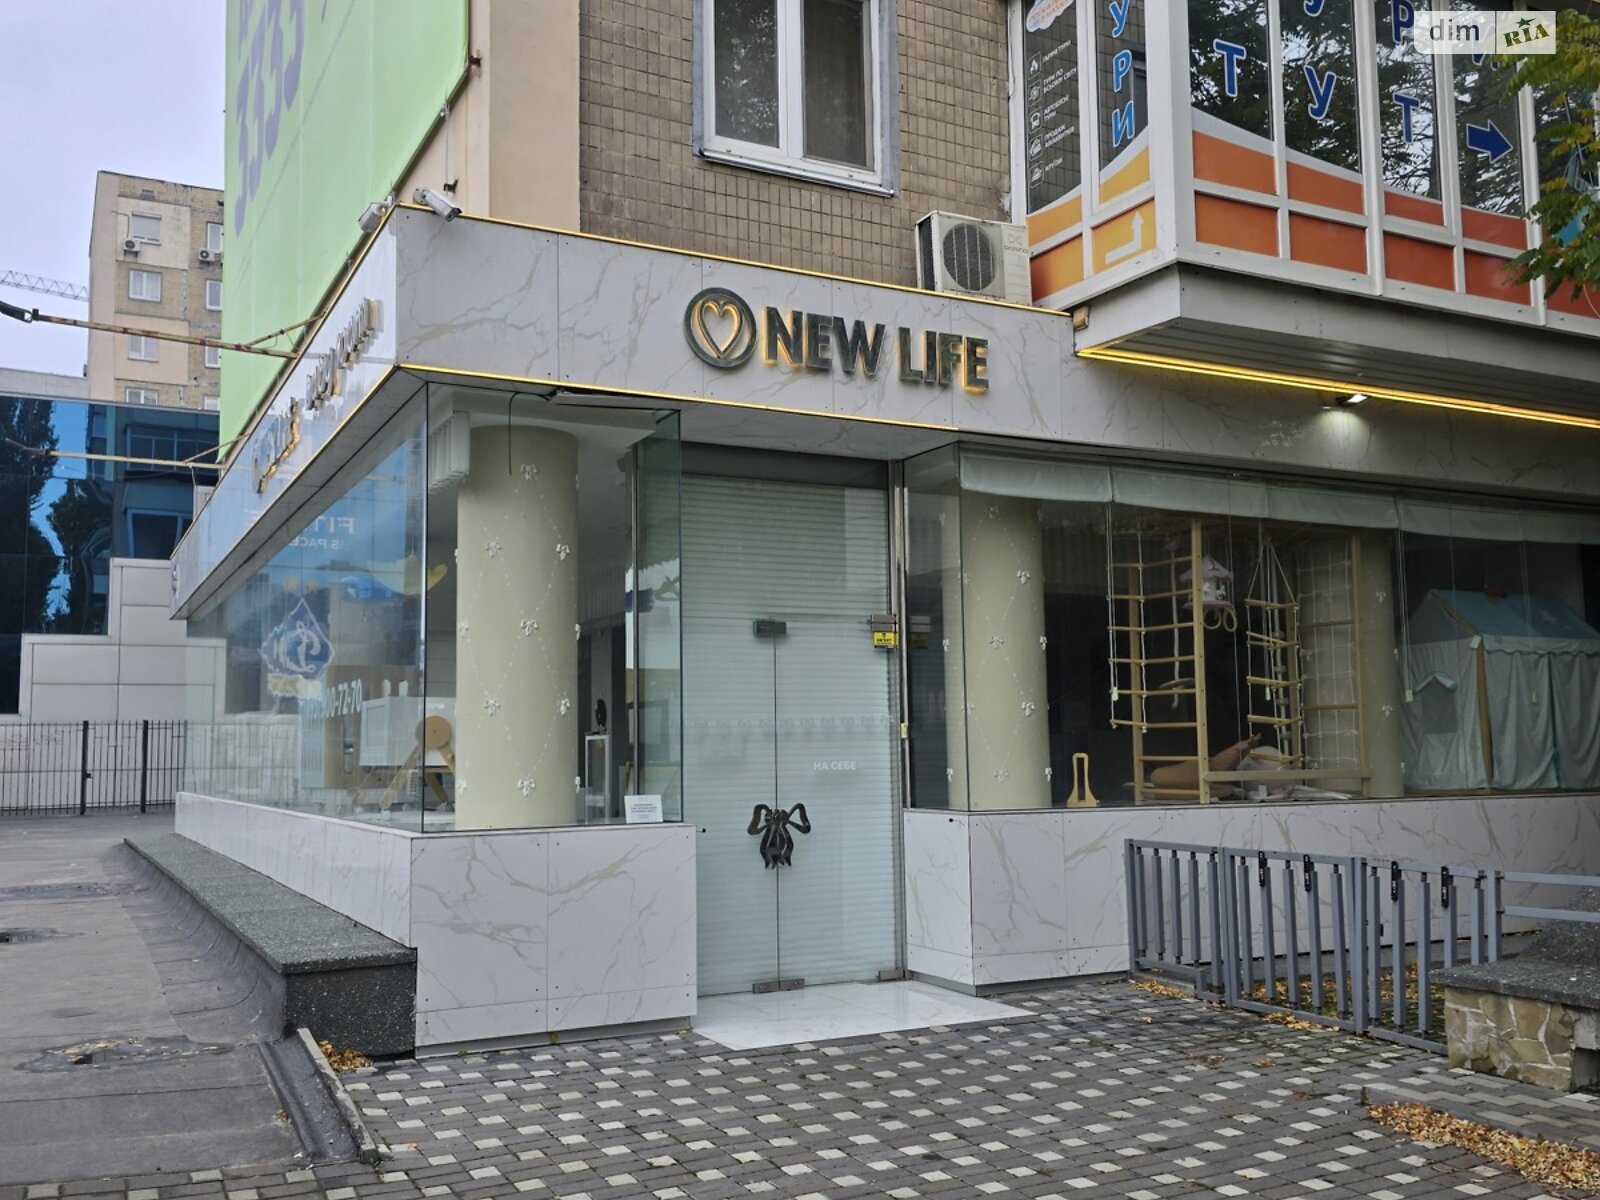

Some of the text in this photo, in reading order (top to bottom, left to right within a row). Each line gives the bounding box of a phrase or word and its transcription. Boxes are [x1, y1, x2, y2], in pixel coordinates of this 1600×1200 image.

[765, 305, 990, 391] NEW LIFE
[813, 761, 857, 771] НА СЕБЕ
